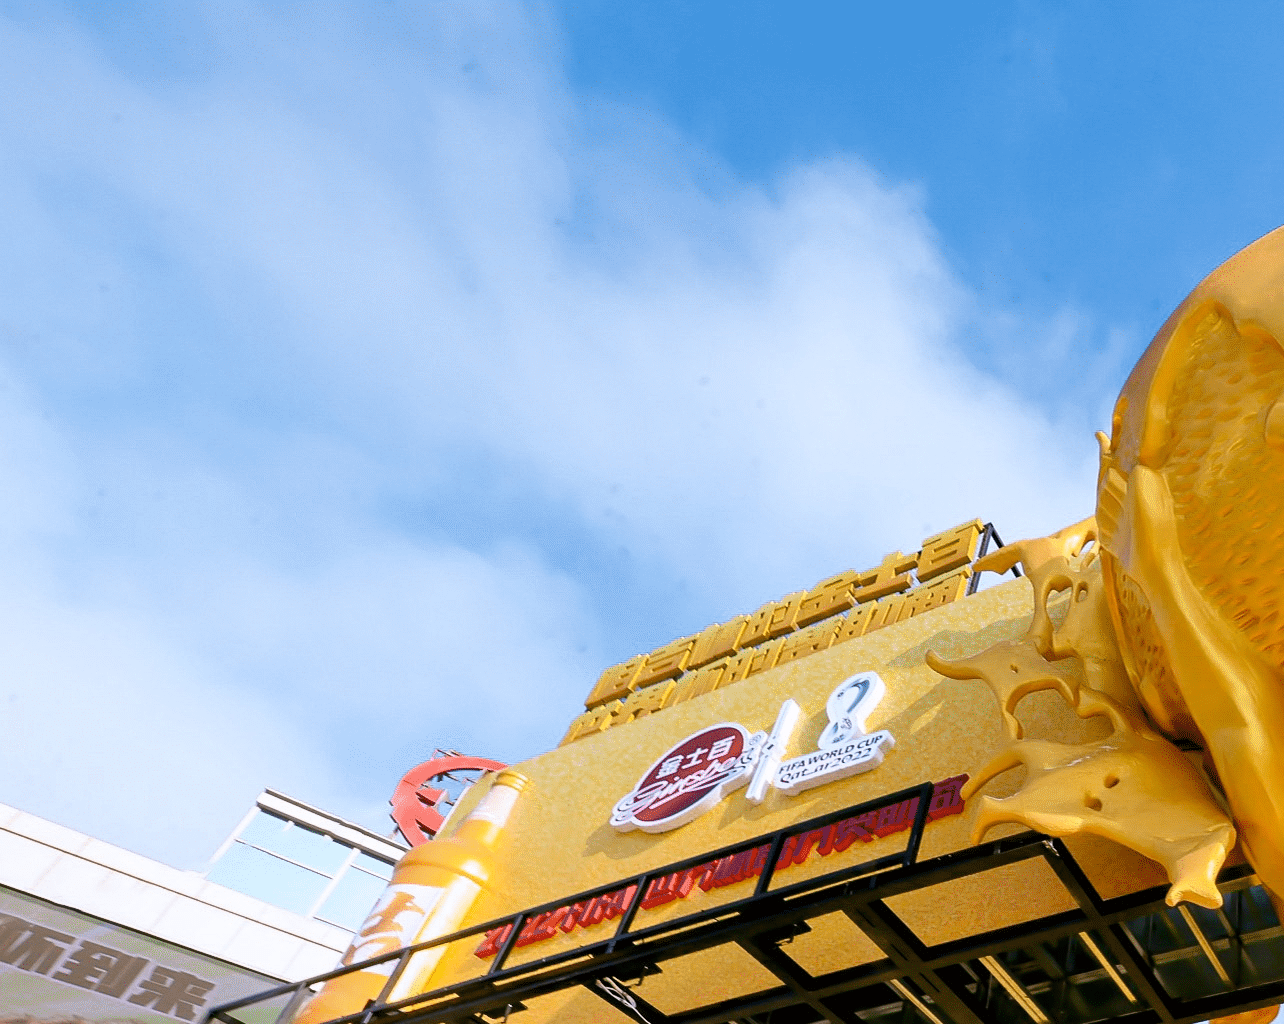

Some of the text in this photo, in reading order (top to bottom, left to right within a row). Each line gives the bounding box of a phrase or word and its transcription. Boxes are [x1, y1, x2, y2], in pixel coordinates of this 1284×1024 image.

[657, 735, 736, 779] 金士百
[779, 735, 883, 774] FIFA WORLD CUP
